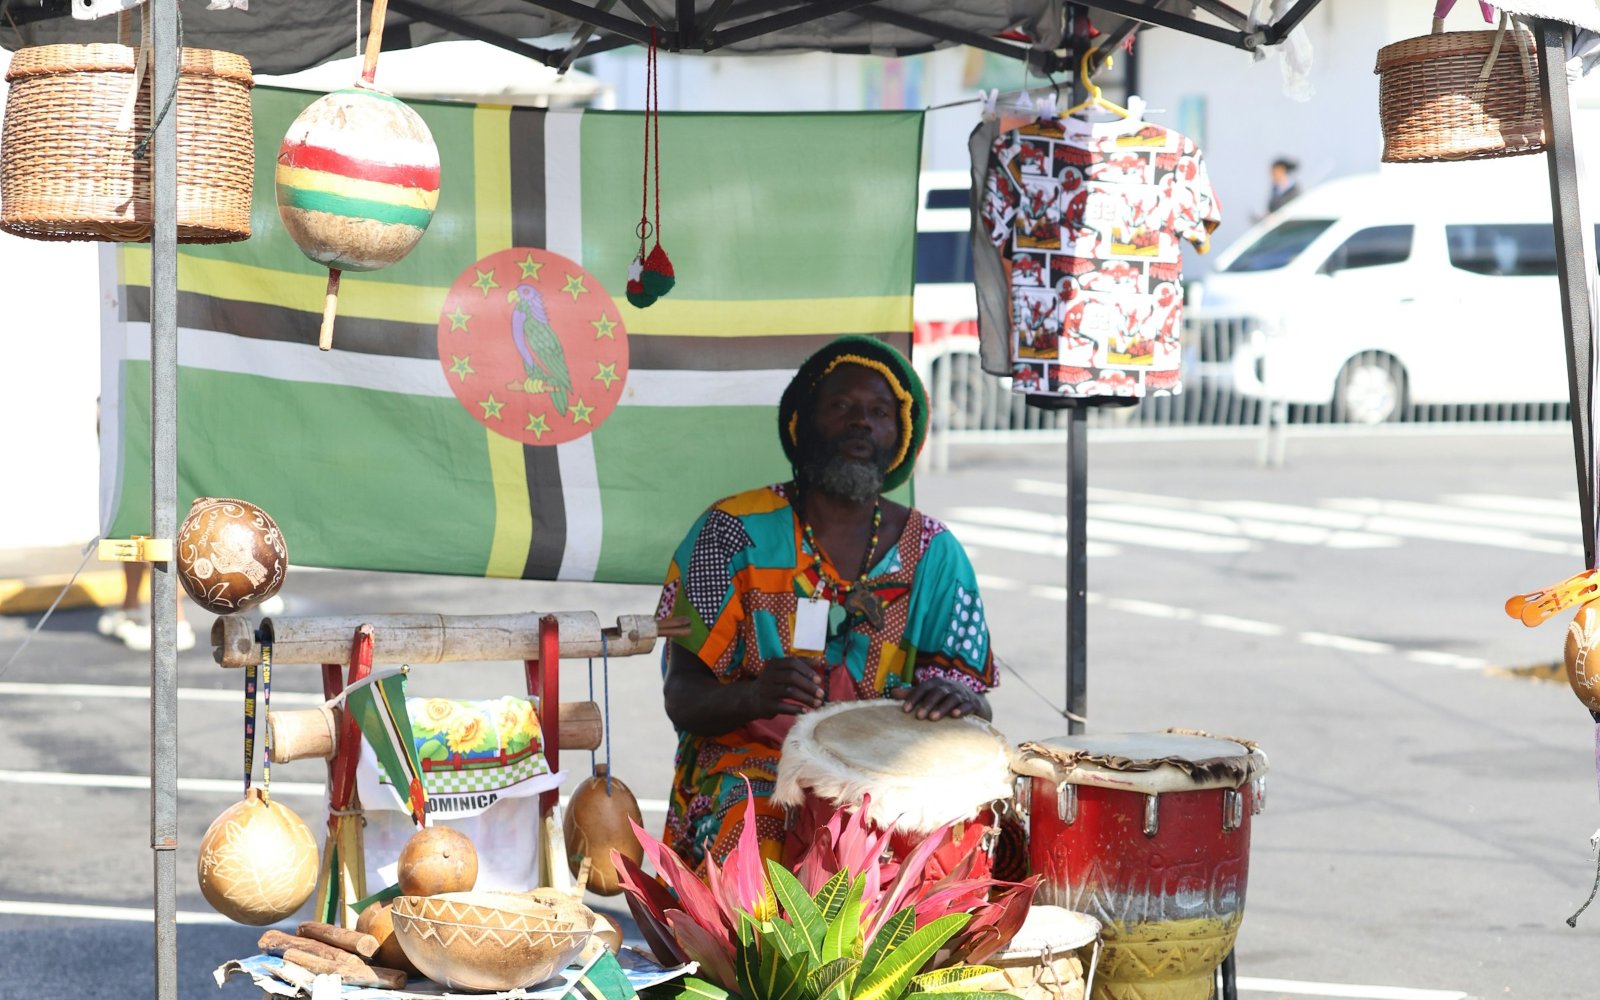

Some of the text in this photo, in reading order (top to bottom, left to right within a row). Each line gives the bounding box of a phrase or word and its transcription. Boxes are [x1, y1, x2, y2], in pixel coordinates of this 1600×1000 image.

[262, 646, 271, 684] NAVY.COM
[245, 698, 255, 718] NAVY
[429, 793, 498, 813] OMINICA
